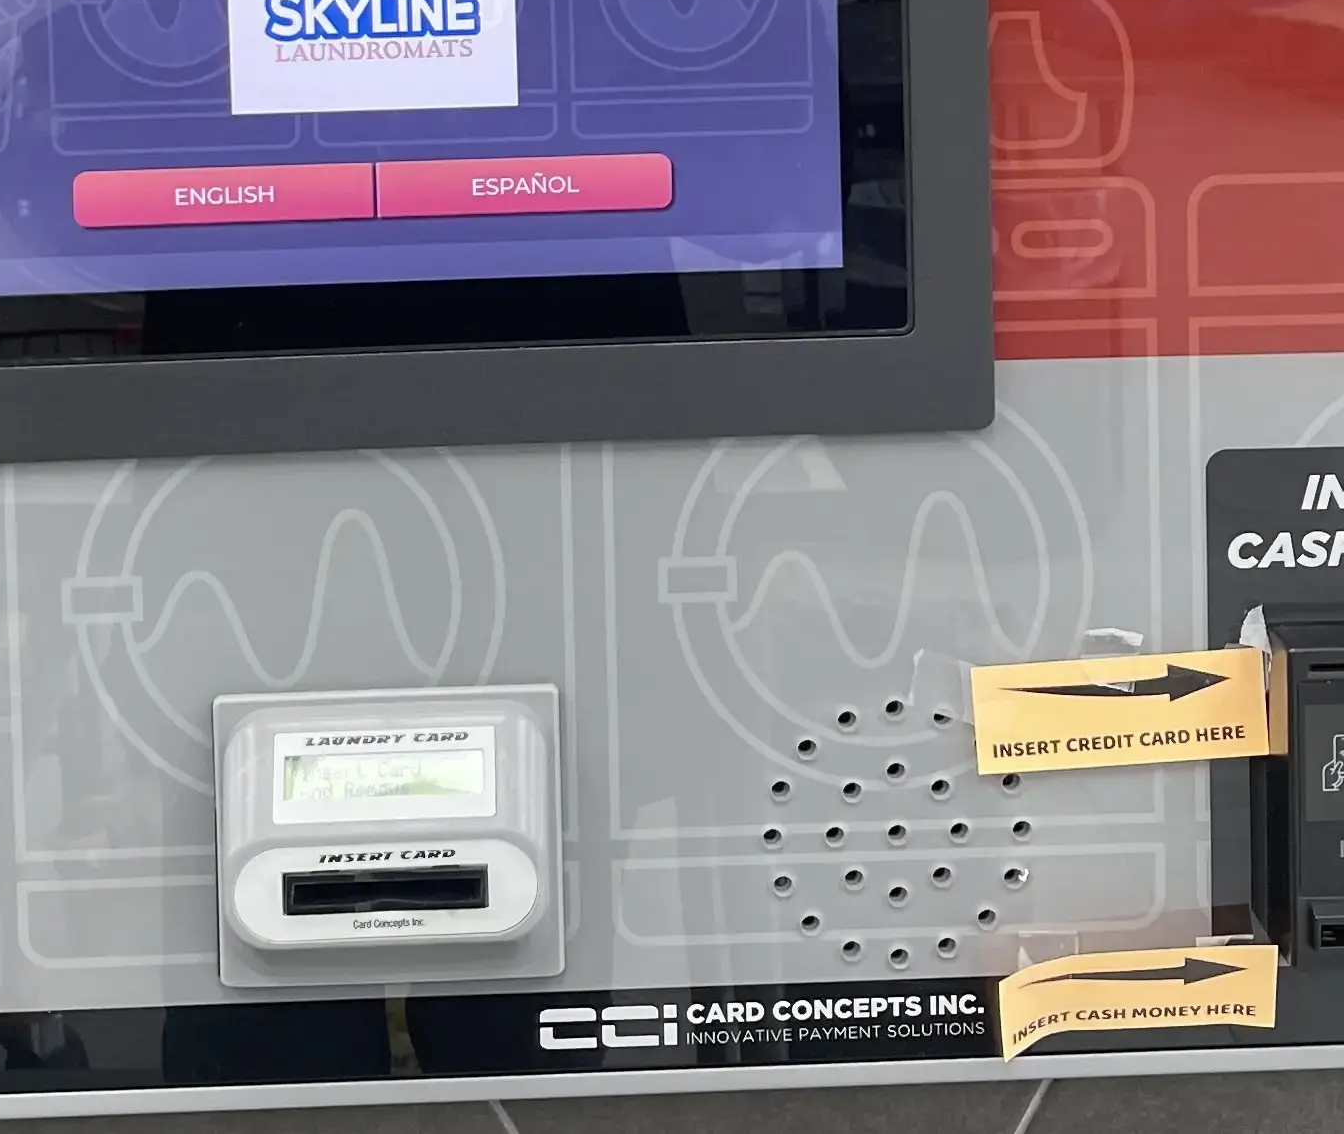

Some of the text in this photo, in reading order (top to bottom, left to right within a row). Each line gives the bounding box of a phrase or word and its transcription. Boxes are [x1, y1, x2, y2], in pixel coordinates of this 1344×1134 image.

[275, 38, 473, 63] LAUNDROMATS
[174, 171, 580, 207] ENGLISH ESPAÑOL
[306, 732, 469, 747] LAUNDRY CARD
[993, 725, 1245, 759] INSERT CREDIT CARD HERE
[319, 849, 456, 864] INSERT CARD
[353, 919, 372, 929] Card
[374, 918, 410, 930] Concepts
[686, 993, 985, 1024] CARD CONCEPTS INC.
[686, 1021, 985, 1046] INNOVATIVE PAYMENT SOLUTIONS
[1012, 1003, 1256, 1045] INSERT CASH MONEY HERE
